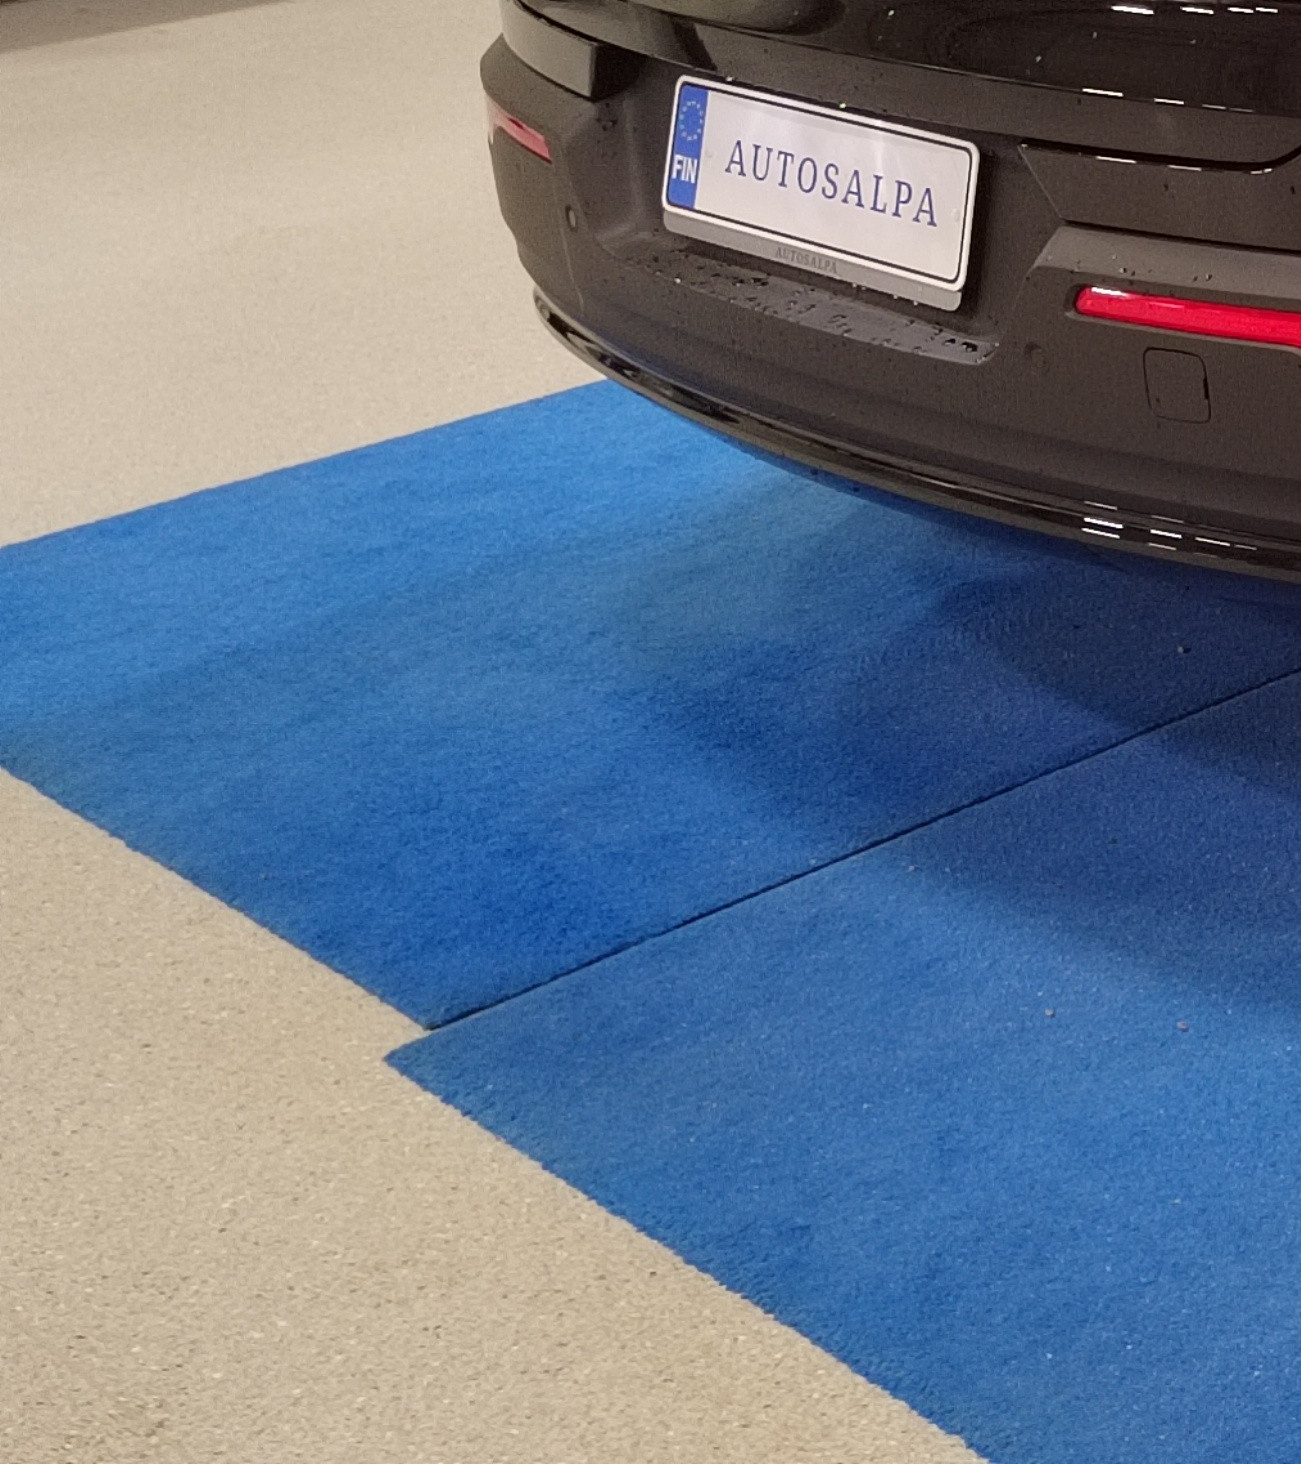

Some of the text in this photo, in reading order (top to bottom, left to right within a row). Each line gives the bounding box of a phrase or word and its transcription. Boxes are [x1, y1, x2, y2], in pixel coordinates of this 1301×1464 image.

[671, 153, 699, 185] FIN
[724, 139, 938, 228] AUTOSALPA
[775, 246, 838, 274] AUTOSALPA
